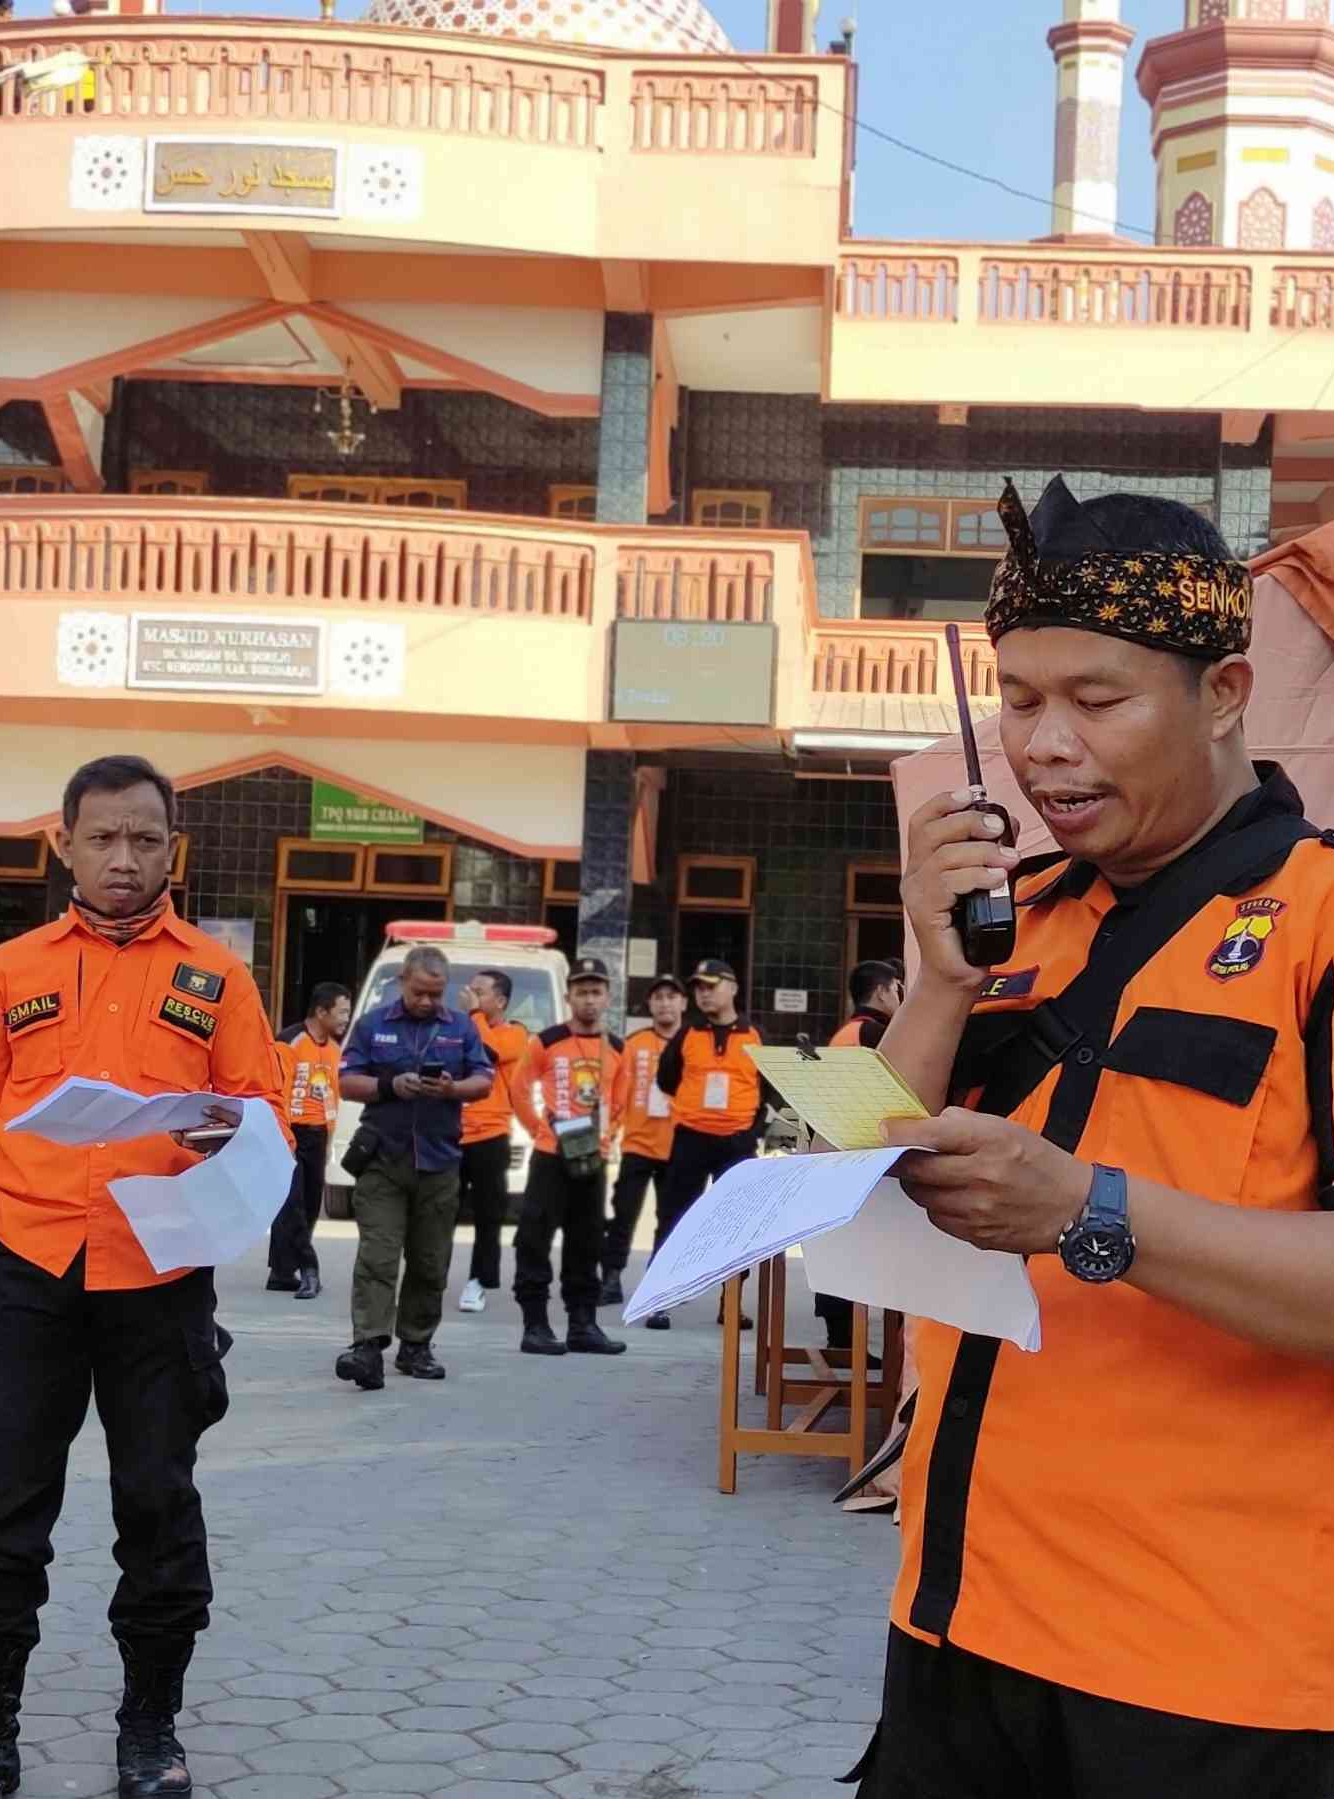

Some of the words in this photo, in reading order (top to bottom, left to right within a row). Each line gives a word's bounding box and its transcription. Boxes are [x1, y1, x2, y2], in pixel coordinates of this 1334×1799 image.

[143, 627, 209, 645] MASJID
[215, 630, 314, 649] NURHASAN
[321, 806, 343, 822] TPQ
[8, 996, 56, 1025] ISMAIL
[165, 998, 216, 1028] RESCUE
[291, 1062, 309, 1117] RESCUE
